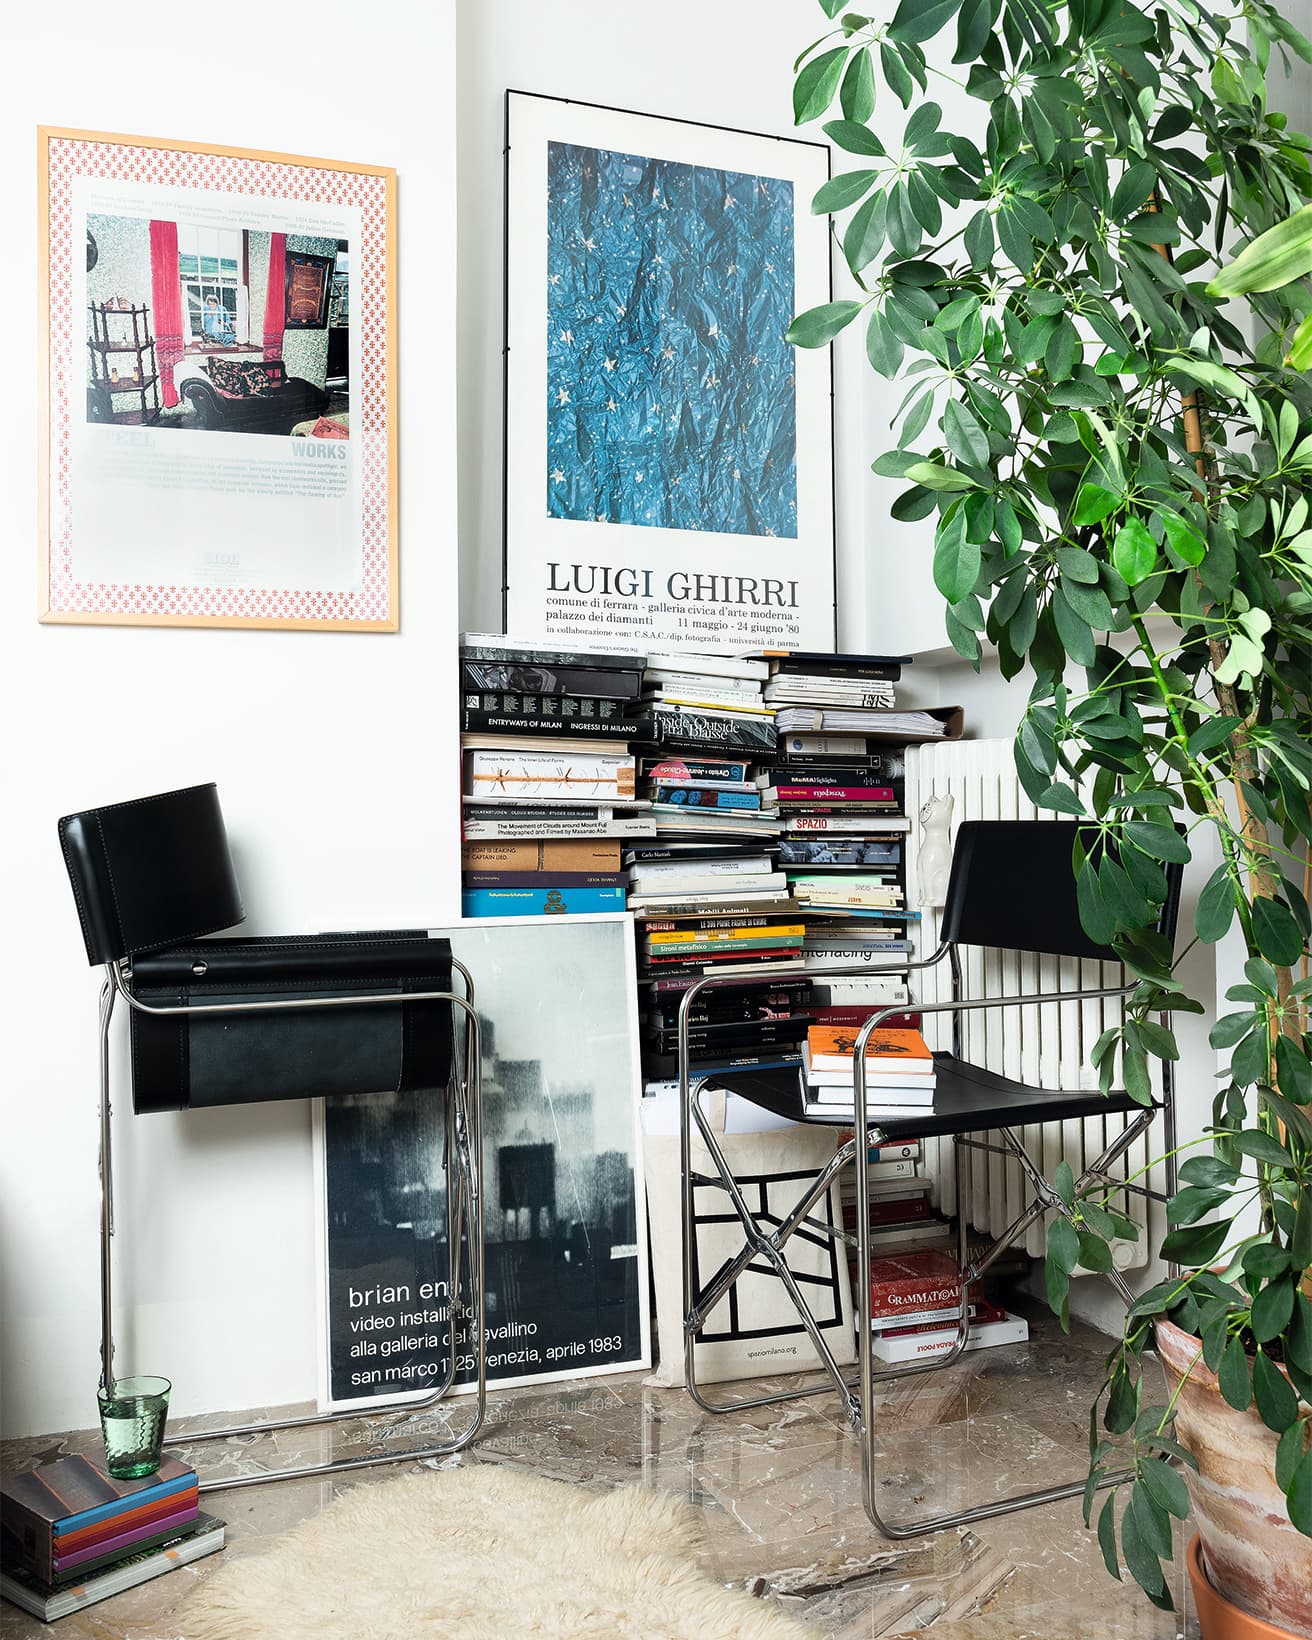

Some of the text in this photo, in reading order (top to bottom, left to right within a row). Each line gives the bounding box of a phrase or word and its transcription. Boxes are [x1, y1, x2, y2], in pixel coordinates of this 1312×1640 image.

[291, 441, 346, 460] WORKS
[546, 562, 800, 608] LUIGI GHIRRI
[546, 597, 588, 607] comune
[590, 597, 600, 608] di
[603, 598, 638, 610] ferrara
[648, 602, 685, 613] galleria
[687, 604, 716, 616] civica
[718, 606, 748, 618] d'arte
[750, 609, 793, 620] moderna
[546, 609, 586, 621] palazzo
[588, 612, 604, 622] dei
[606, 612, 653, 625] diamanti
[678, 618, 688, 628] 11
[692, 620, 728, 631] maggio
[737, 621, 748, 631] 24
[750, 622, 783, 634] giugno
[786, 624, 800, 634] '80
[546, 625, 554, 633] in
[557, 625, 613, 636] collaborazione
[685, 633, 721, 643] fotografia
[729, 636, 765, 646] università
[767, 638, 775, 646] di
[777, 640, 800, 648] parma
[488, 718, 528, 727] ENTRYWAYS
[529, 720, 539, 728] OF
[540, 720, 563, 729] MILAN
[570, 722, 601, 730] INGRESSI
[601, 723, 609, 731] DI
[653, 712, 740, 734] Inside Outside
[689, 723, 728, 740] Blaisse
[660, 766, 729, 777] Christo Jeanne-Claude
[813, 789, 847, 798] Persepolis
[796, 818, 828, 829] SPAZIO
[701, 920, 706, 929] LE
[660, 945, 677, 953] Sironi
[678, 943, 707, 952] metafisico
[349, 1284, 410, 1308] brian
[350, 1315, 395, 1333] video
[350, 1340, 377, 1358] alla
[380, 1333, 438, 1357] galleria
[485, 1323, 537, 1341] avallino
[351, 1370, 381, 1385] san
[385, 1362, 438, 1380] marco
[546, 1342, 586, 1361] aprile
[588, 1335, 622, 1353] 1983
[747, 1346, 797, 1360] spaziomilano.org
